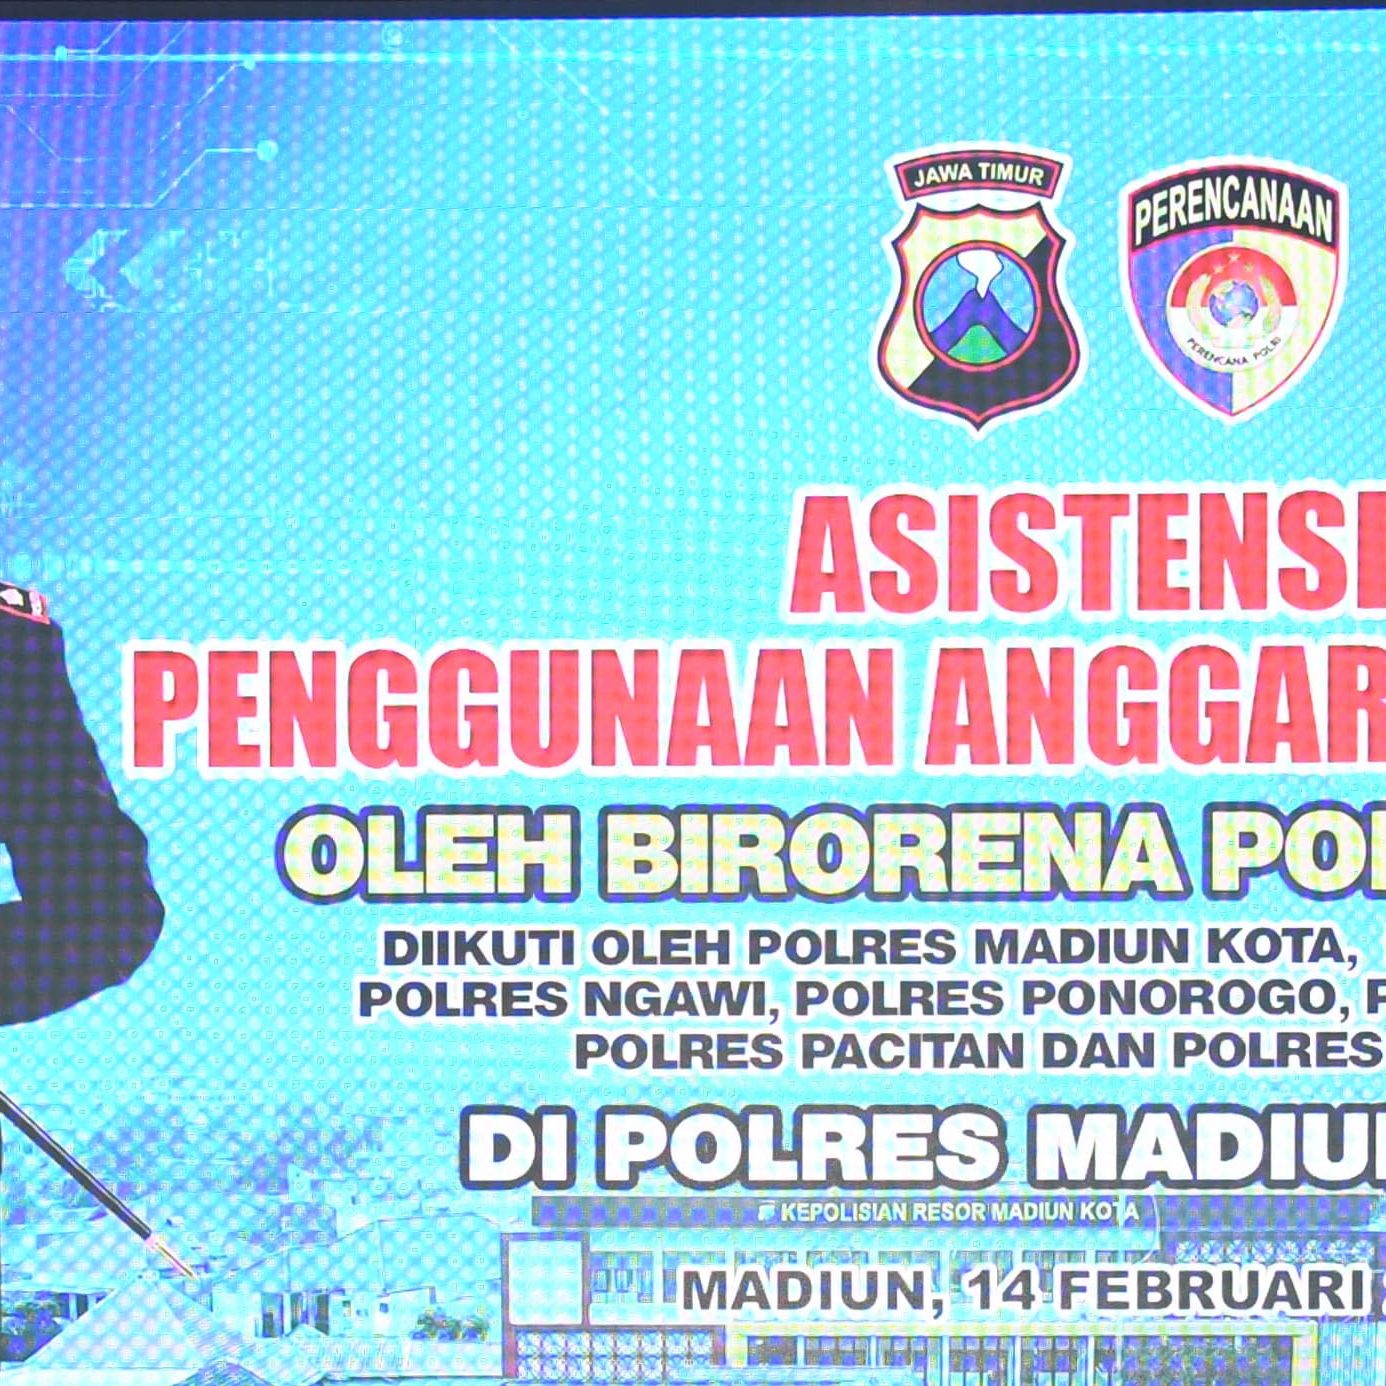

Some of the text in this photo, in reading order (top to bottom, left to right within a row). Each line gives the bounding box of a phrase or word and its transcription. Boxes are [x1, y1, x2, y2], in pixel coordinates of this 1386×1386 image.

[914, 163, 1045, 188] JAWA TIMUR
[1135, 175, 1333, 245] PERENCANAAN
[133, 648, 894, 768] PENGGUNAAN
[283, 812, 572, 895] OLEH
[608, 810, 1183, 895] BIRORENA
[383, 929, 574, 966] DIIKUTI
[592, 928, 730, 966] OLEH
[749, 928, 956, 966] POLRES
[975, 927, 1188, 965] MADIUN
[1207, 927, 1357, 970] KOTA,
[360, 981, 568, 1018] POLRES
[584, 980, 780, 1024] NGAWI,
[797, 980, 1004, 1017] POLRES
[1024, 979, 1349, 1022] PONOROGO,
[575, 1033, 783, 1070] POLRES
[802, 1032, 1022, 1069] PACITAN
[1043, 1032, 1154, 1069] DAN
[1174, 1031, 1383, 1069] POLRES
[467, 1113, 568, 1182] DI
[604, 1111, 1002, 1183] POLRES
[781, 1201, 1139, 1222] KEPOLISIAN RESOR MADIUN KOTA
[682, 1270, 944, 1317] MADIUN,
[968, 1270, 1035, 1311] 14
[1061, 1270, 1364, 1311] FEBRUARI
